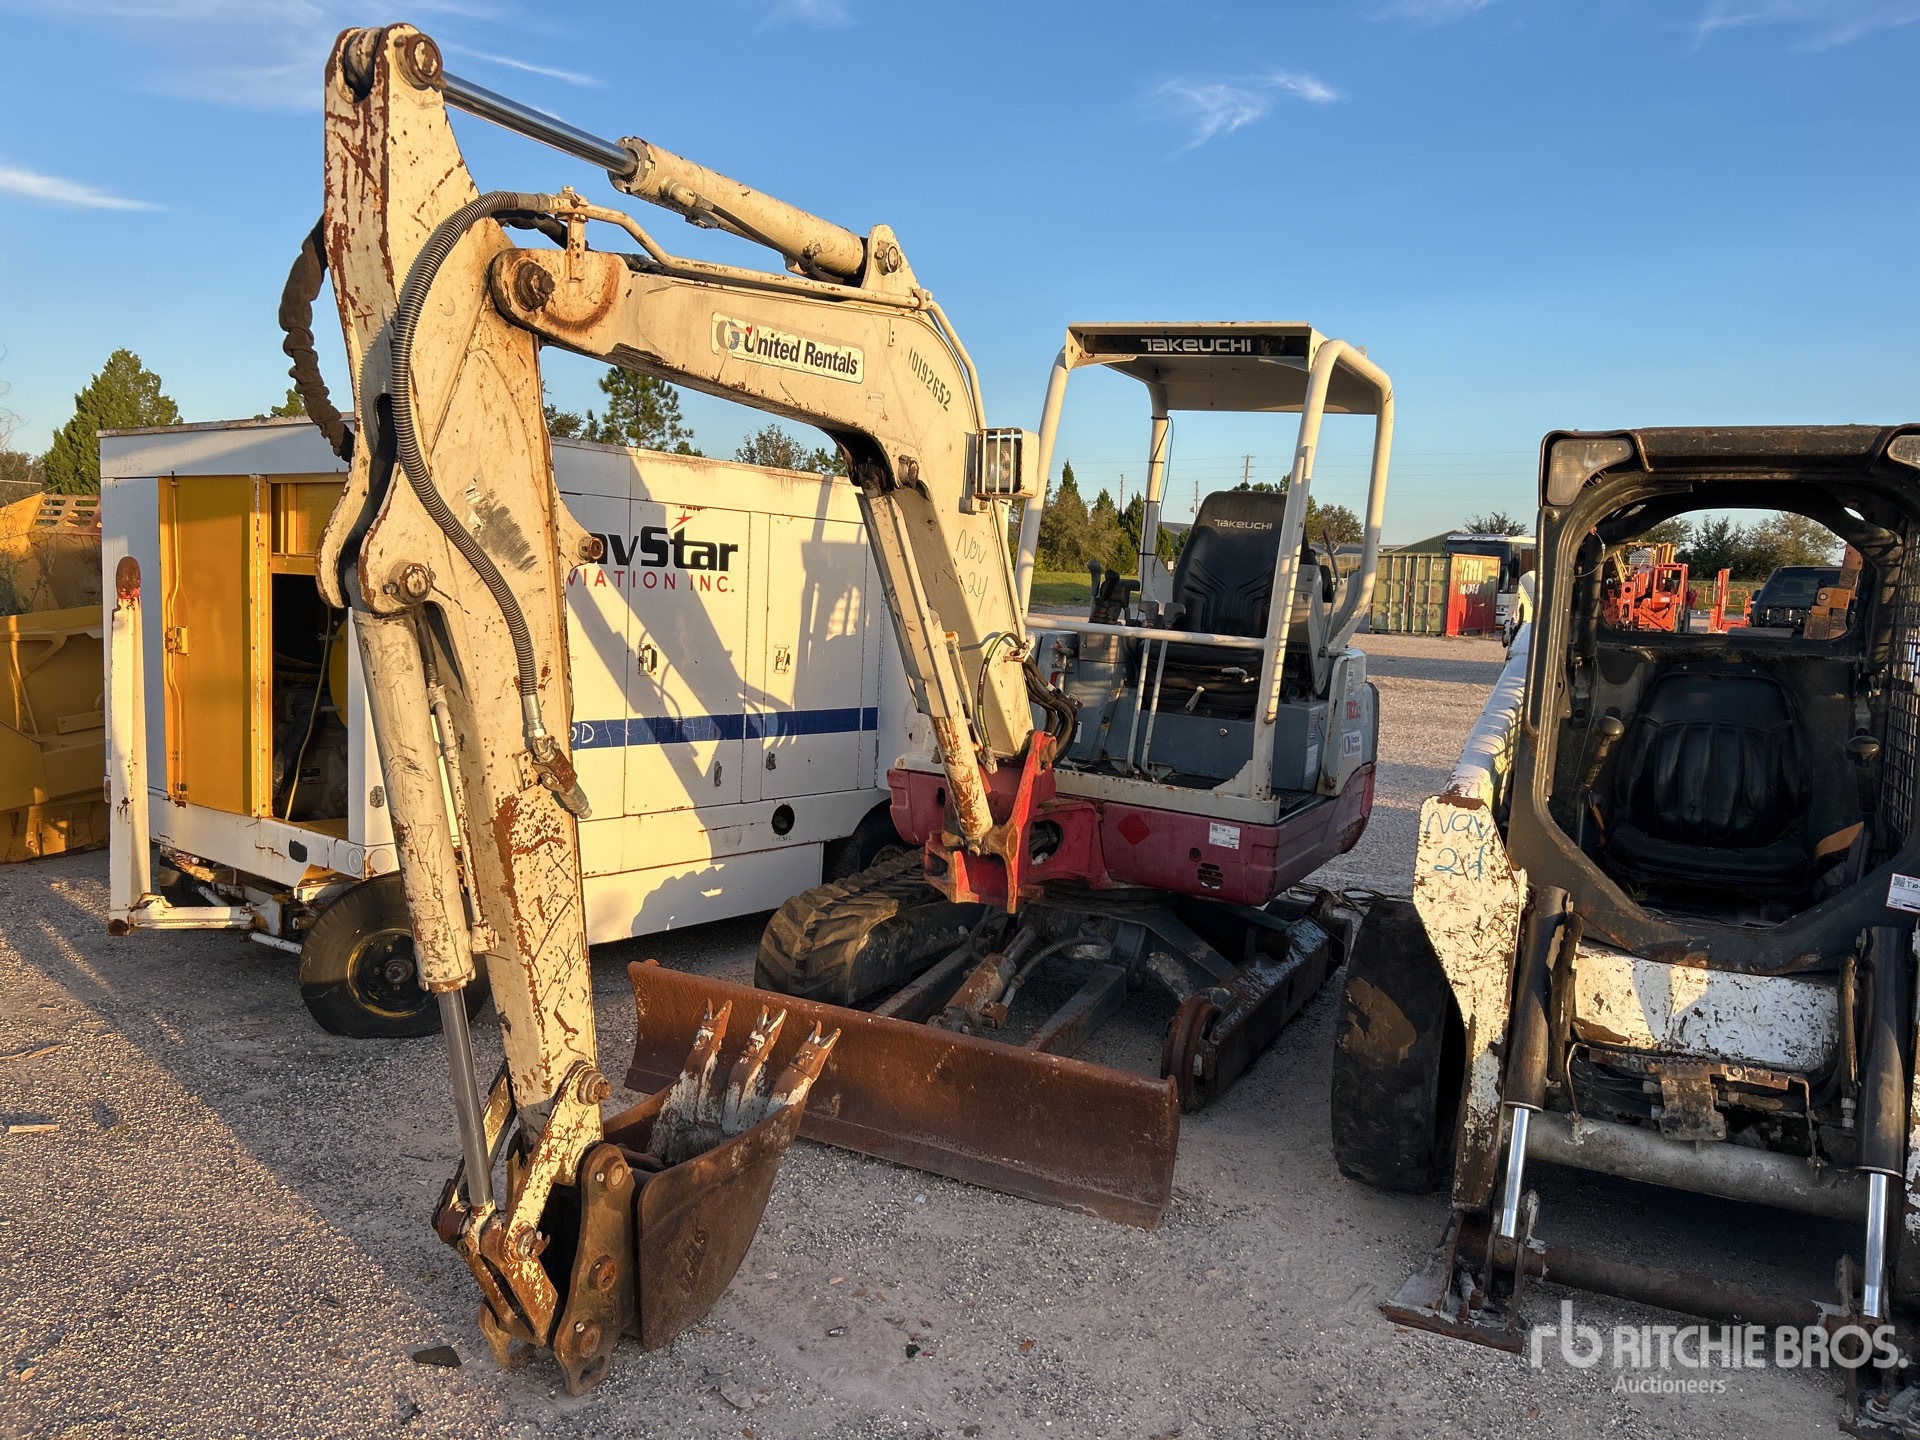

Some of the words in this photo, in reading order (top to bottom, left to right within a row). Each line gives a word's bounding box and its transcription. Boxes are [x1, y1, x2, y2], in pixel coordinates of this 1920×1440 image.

[744, 329, 801, 363] United
[804, 341, 858, 375] Rentals
[1140, 338, 1252, 353] TAKEUCHI
[908, 346, 952, 412] 10192652
[689, 574, 735, 593] INC.
[968, 571, 988, 617] 24
[1433, 844, 1486, 882] 24
